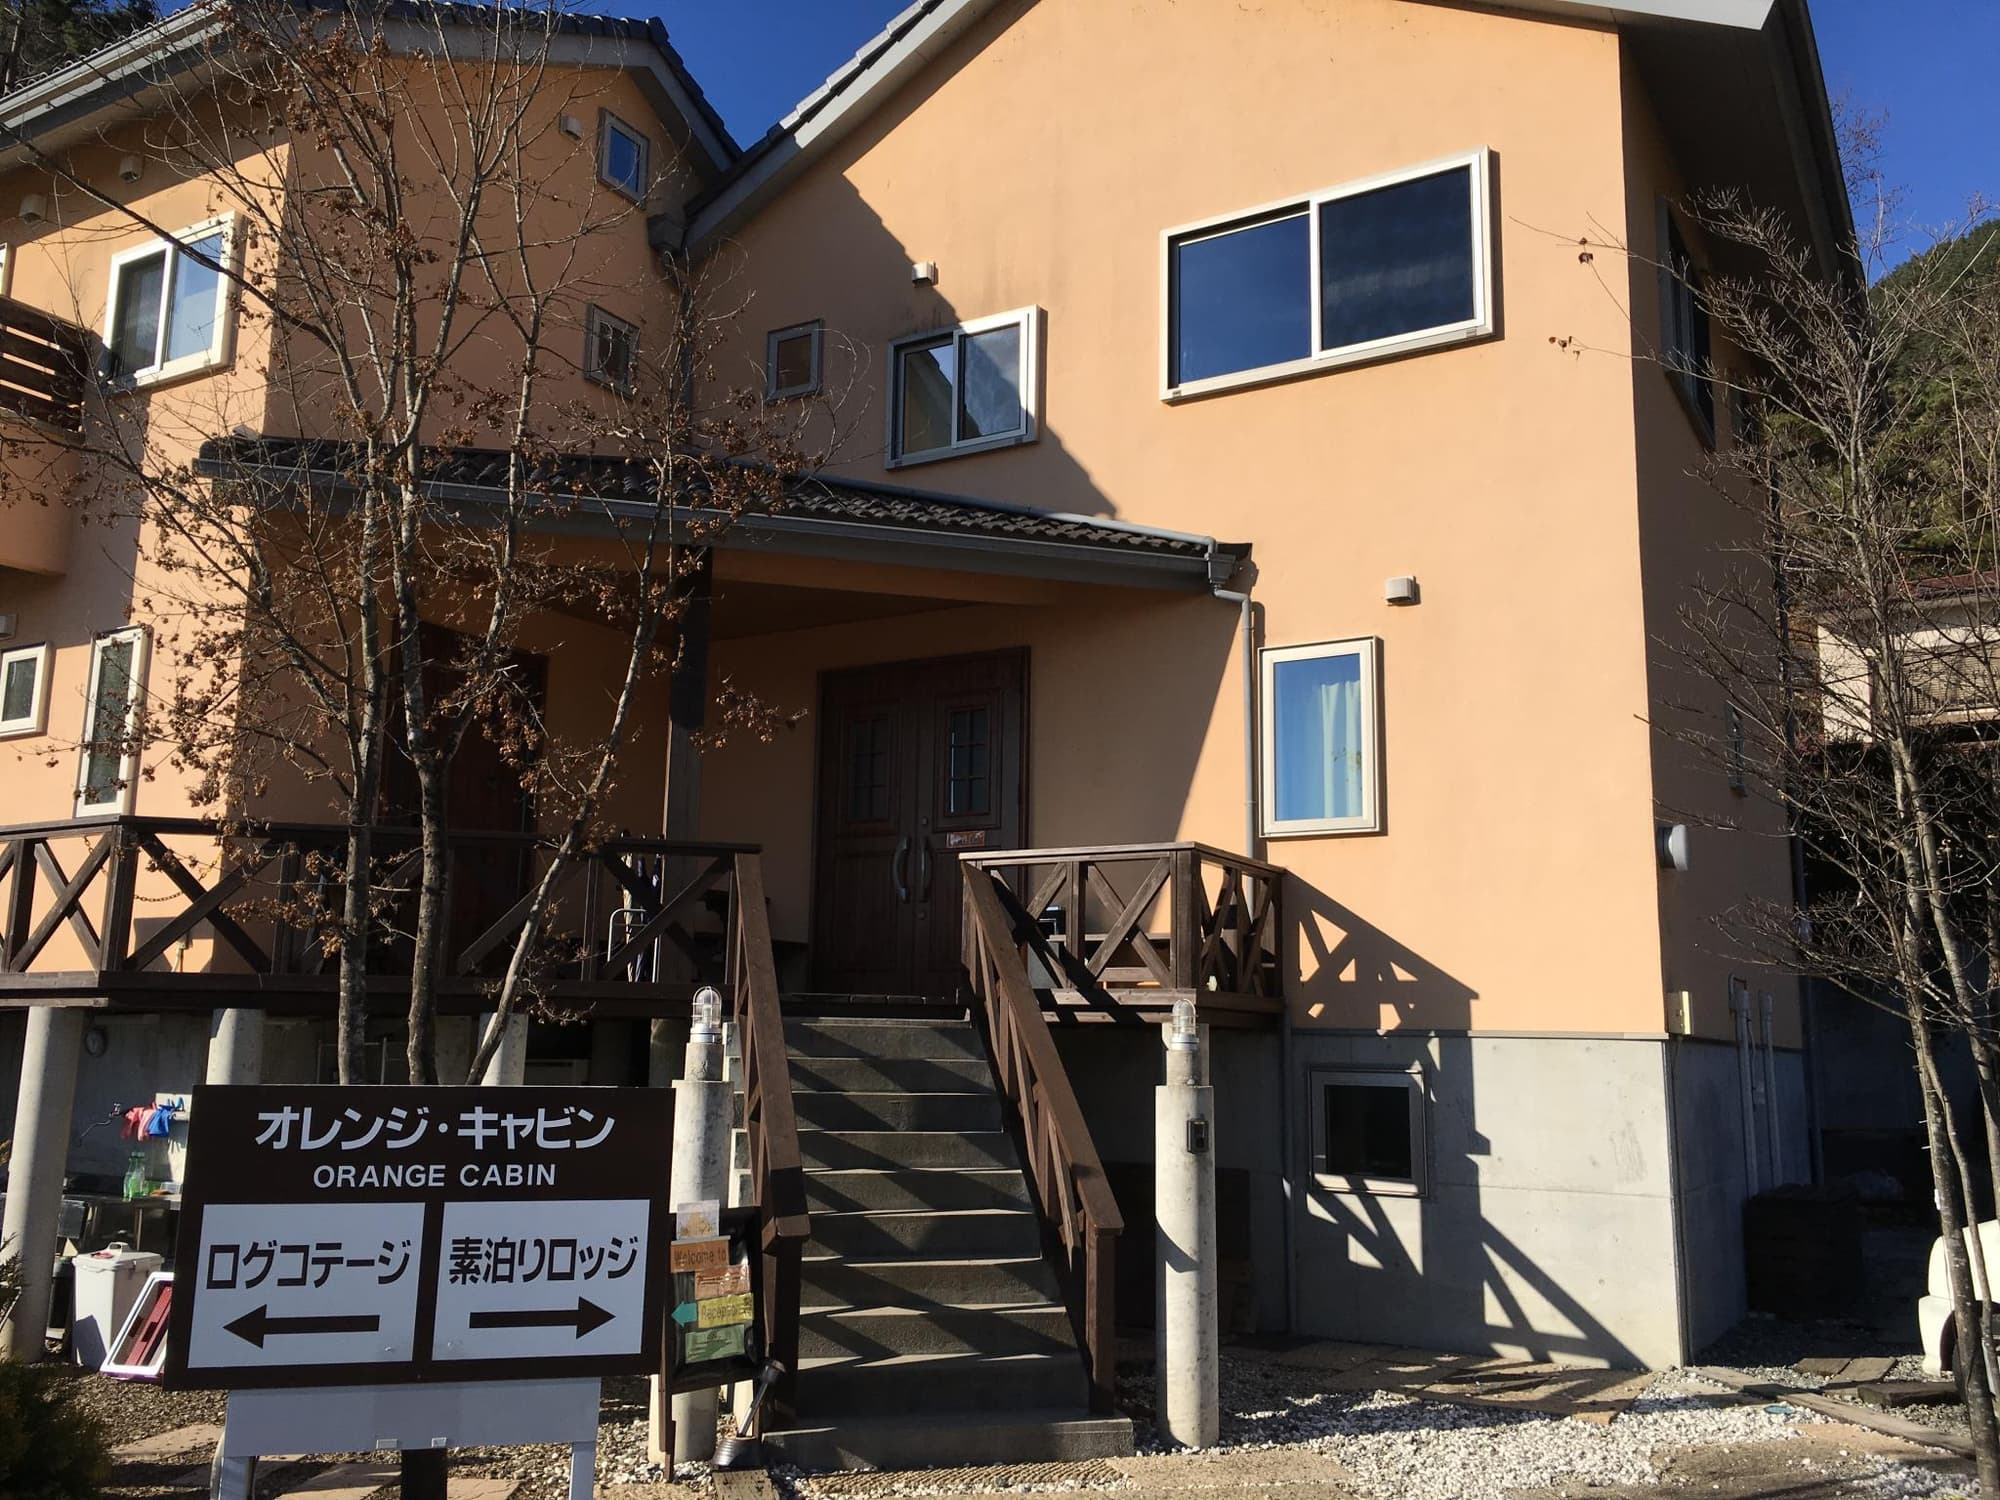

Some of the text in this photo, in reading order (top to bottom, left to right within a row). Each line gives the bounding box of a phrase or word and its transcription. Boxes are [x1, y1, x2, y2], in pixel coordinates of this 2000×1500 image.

[255, 1106, 616, 1150] オレンジ・キャビン
[313, 1163, 557, 1188] ORANGE CABIN
[206, 1239, 411, 1289] ログコテージ
[449, 1236, 638, 1285] 素泊りロッジ
